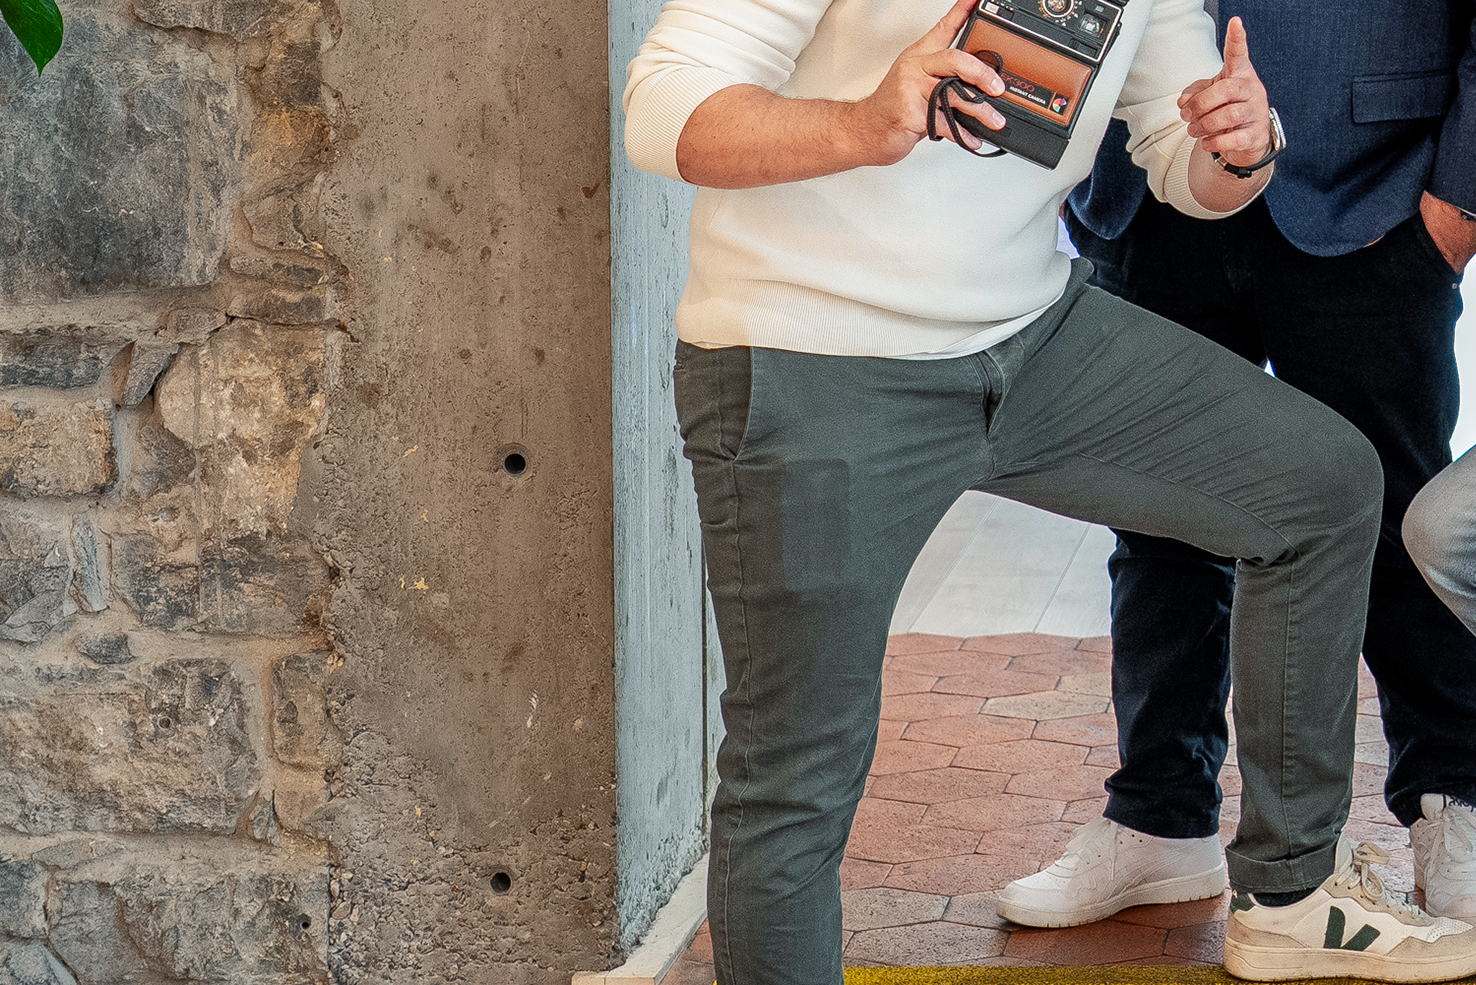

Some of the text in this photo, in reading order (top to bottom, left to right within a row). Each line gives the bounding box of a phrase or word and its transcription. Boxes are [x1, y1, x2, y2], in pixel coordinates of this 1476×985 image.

[1000, 72, 1035, 93] EK300
[1009, 85, 1046, 105] INSTANT CAMERA
